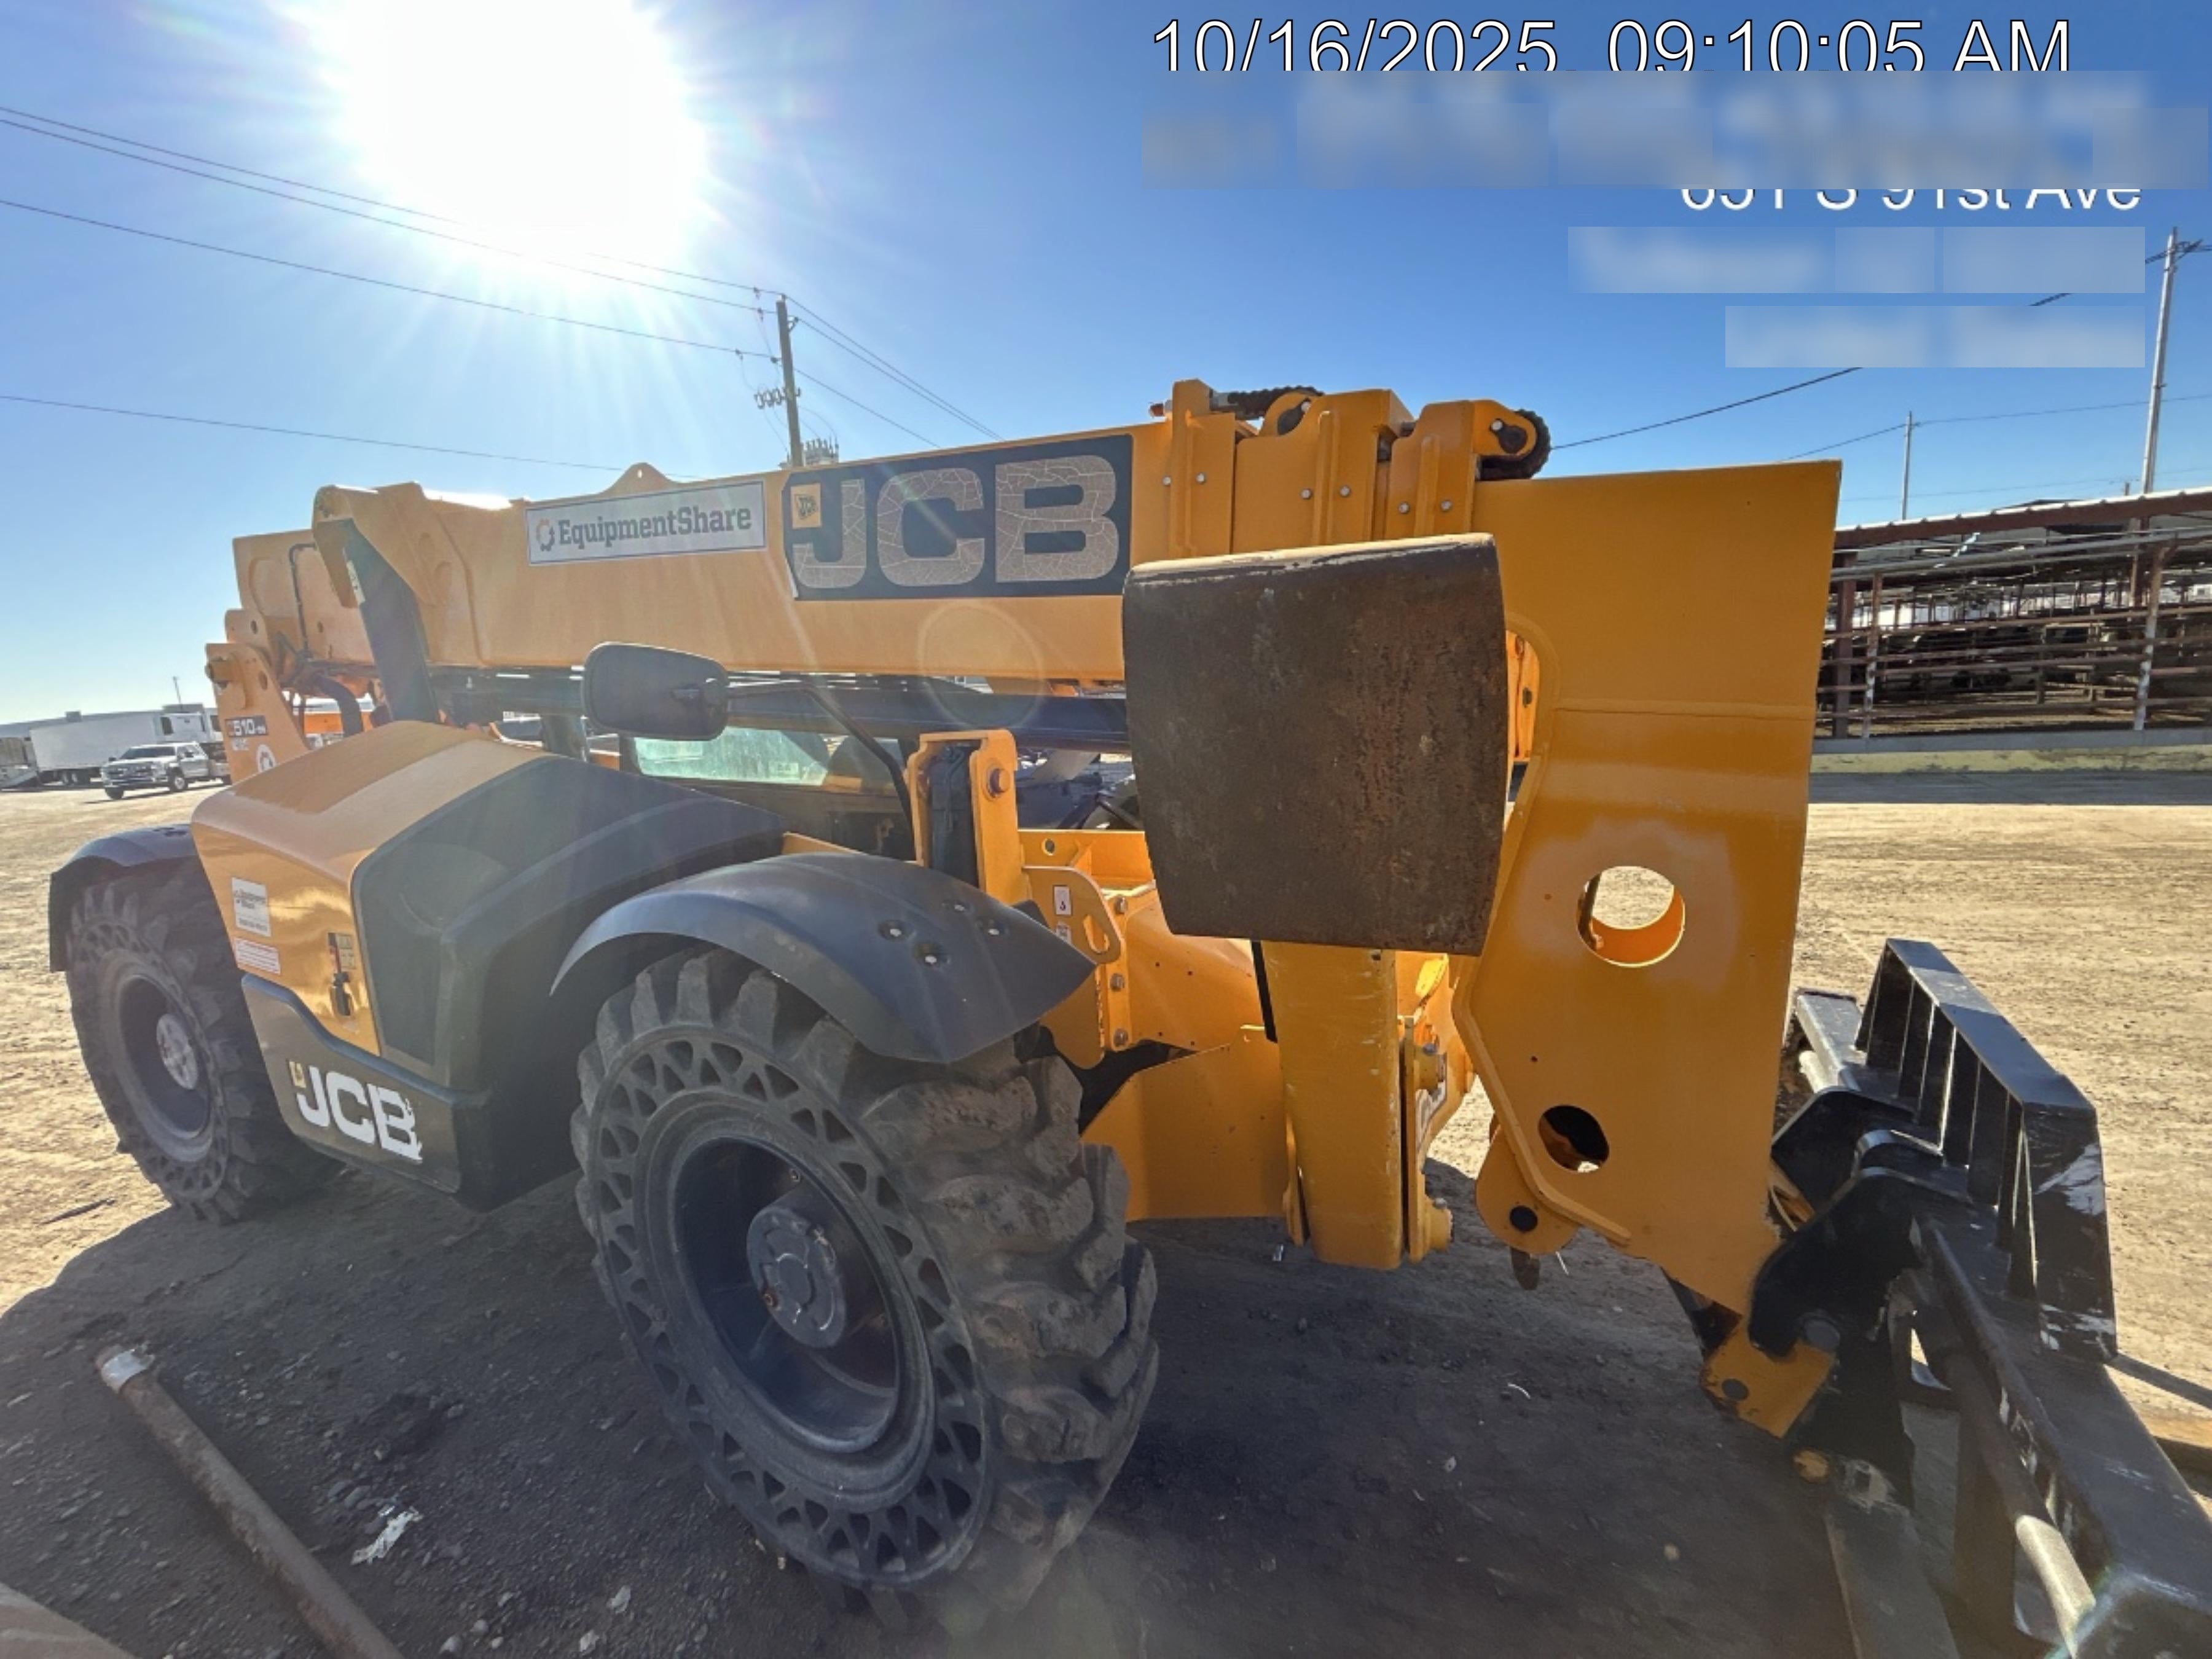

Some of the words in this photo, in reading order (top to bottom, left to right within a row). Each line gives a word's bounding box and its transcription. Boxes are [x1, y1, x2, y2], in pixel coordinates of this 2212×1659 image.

[558, 504, 751, 549] EquipmentShare
[793, 455, 1119, 589] JCB
[296, 1065, 423, 1163] JCB
